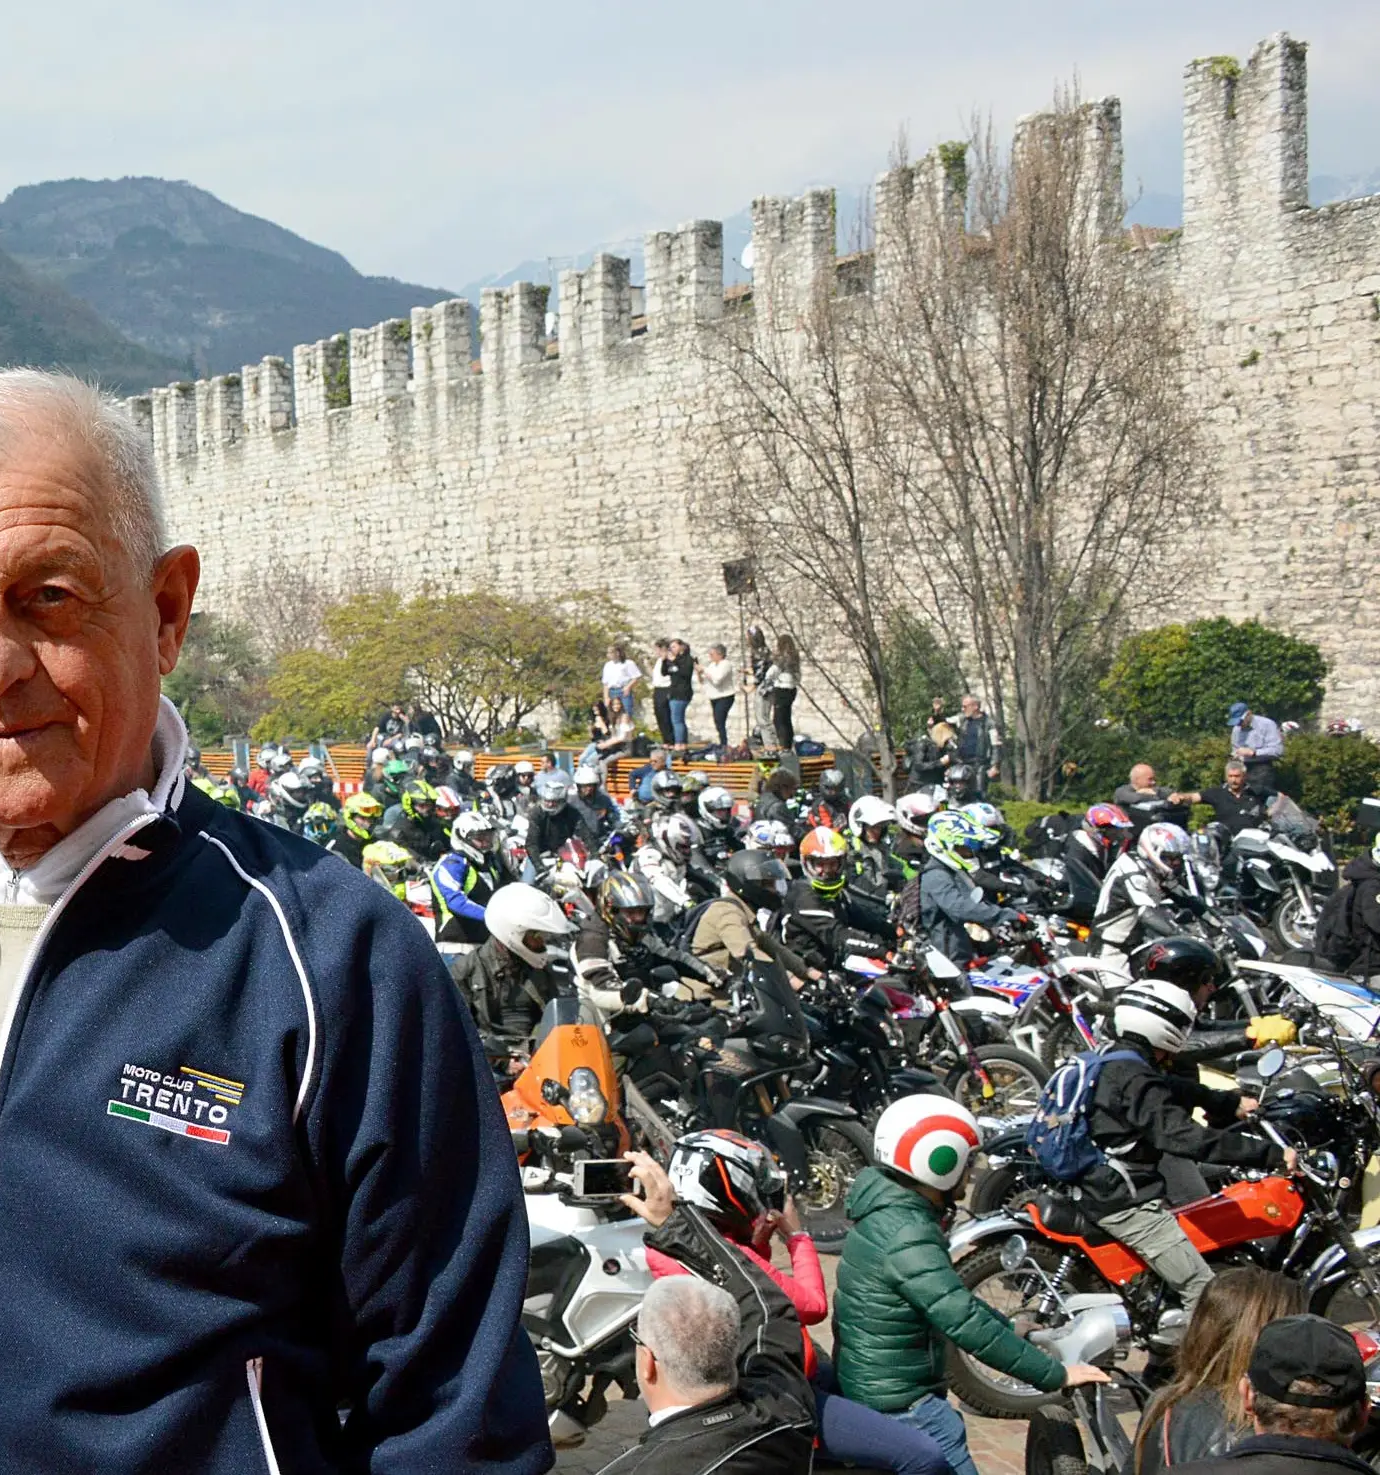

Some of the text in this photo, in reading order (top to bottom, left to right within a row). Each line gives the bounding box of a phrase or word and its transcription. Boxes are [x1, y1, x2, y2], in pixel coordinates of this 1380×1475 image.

[122, 1063, 194, 1092] MOTO CLUB
[120, 1077, 228, 1124] TRENTO
